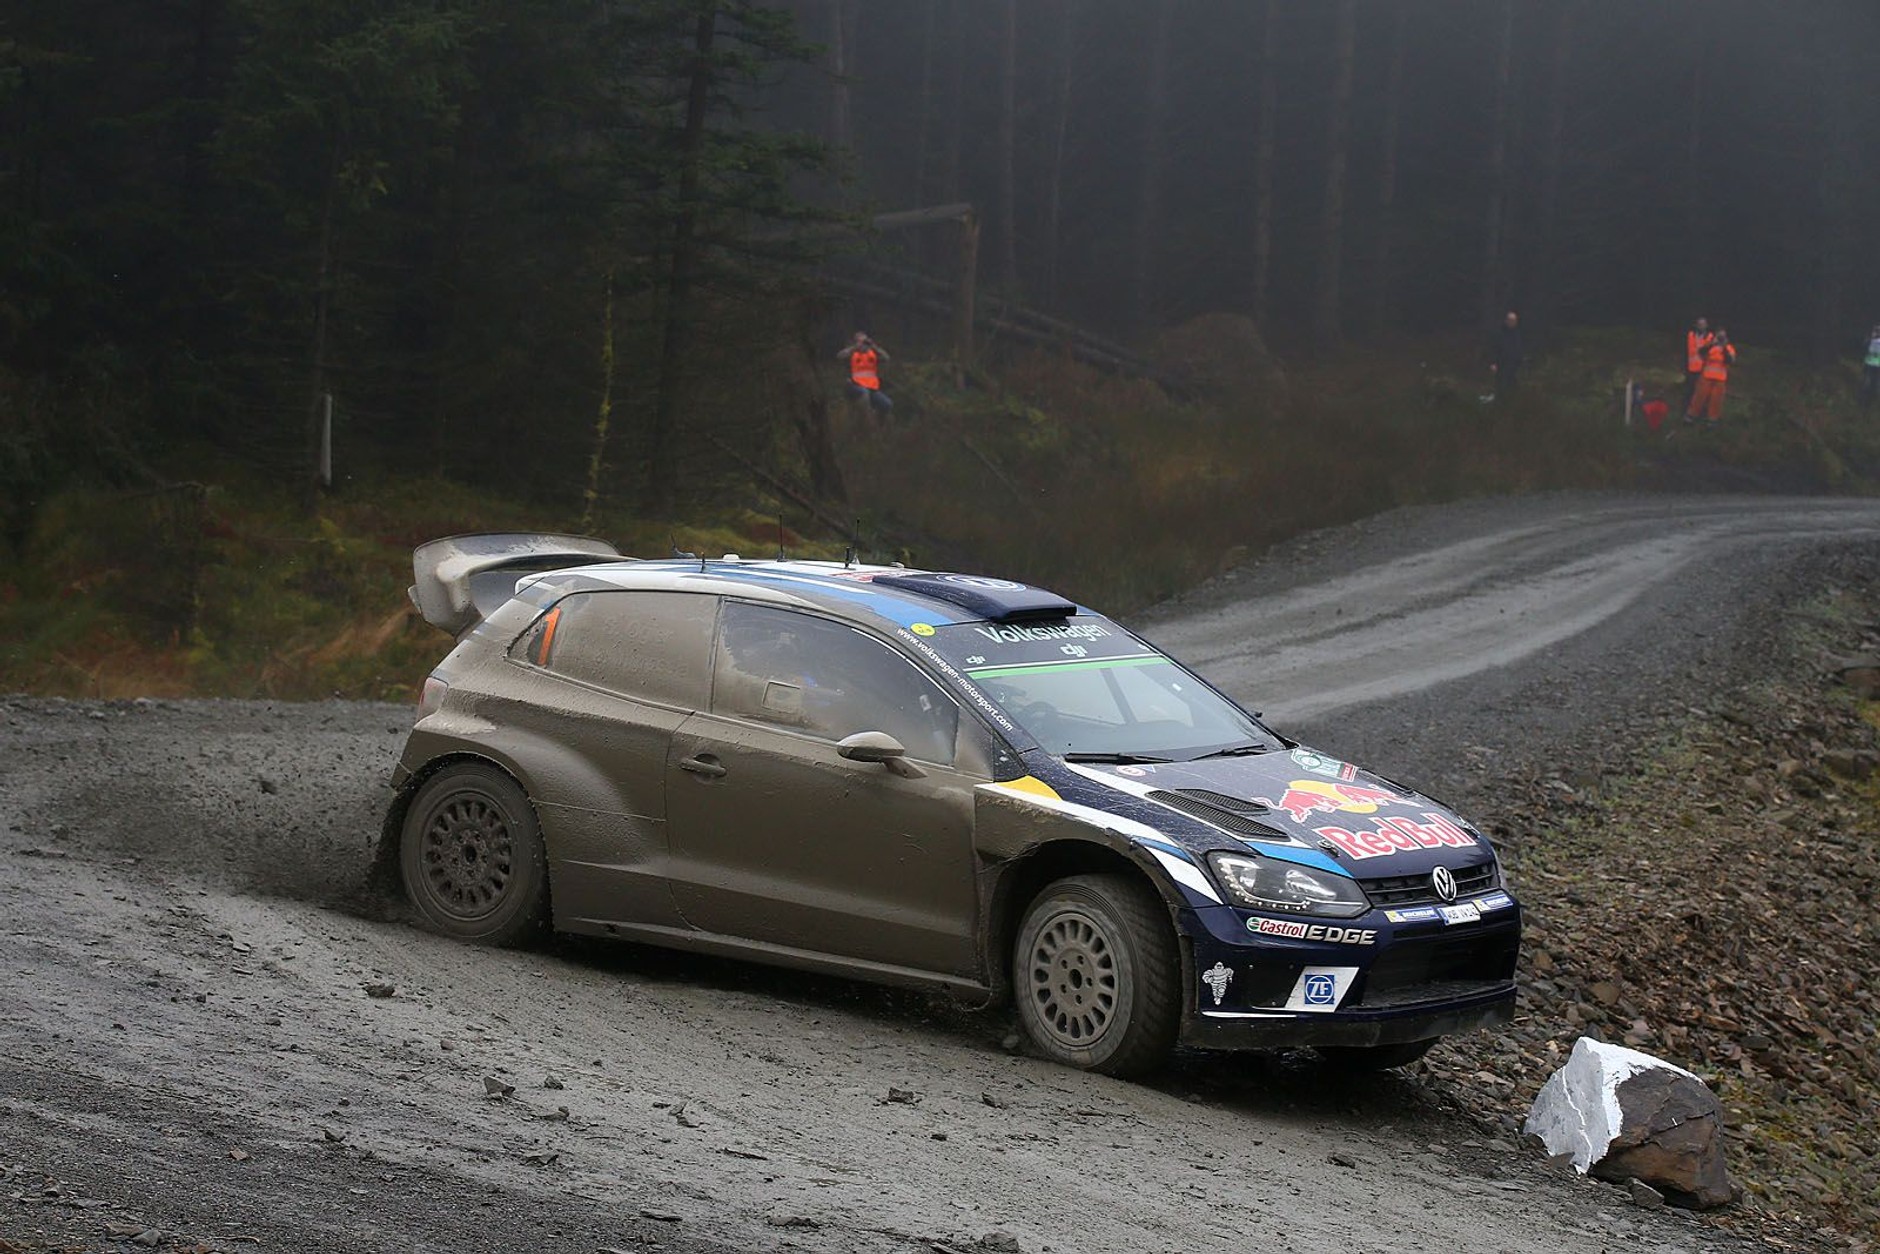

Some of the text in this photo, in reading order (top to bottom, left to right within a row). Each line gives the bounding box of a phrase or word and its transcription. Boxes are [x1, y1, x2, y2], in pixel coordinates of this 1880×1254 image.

[537, 607, 561, 666] 1
[974, 624, 1112, 645] Volkswagen
[897, 628, 1014, 732] www.volkswagen-motorsport.com
[1260, 920, 1378, 945] Castrol EDGE
[1308, 981, 1330, 998] ZF
